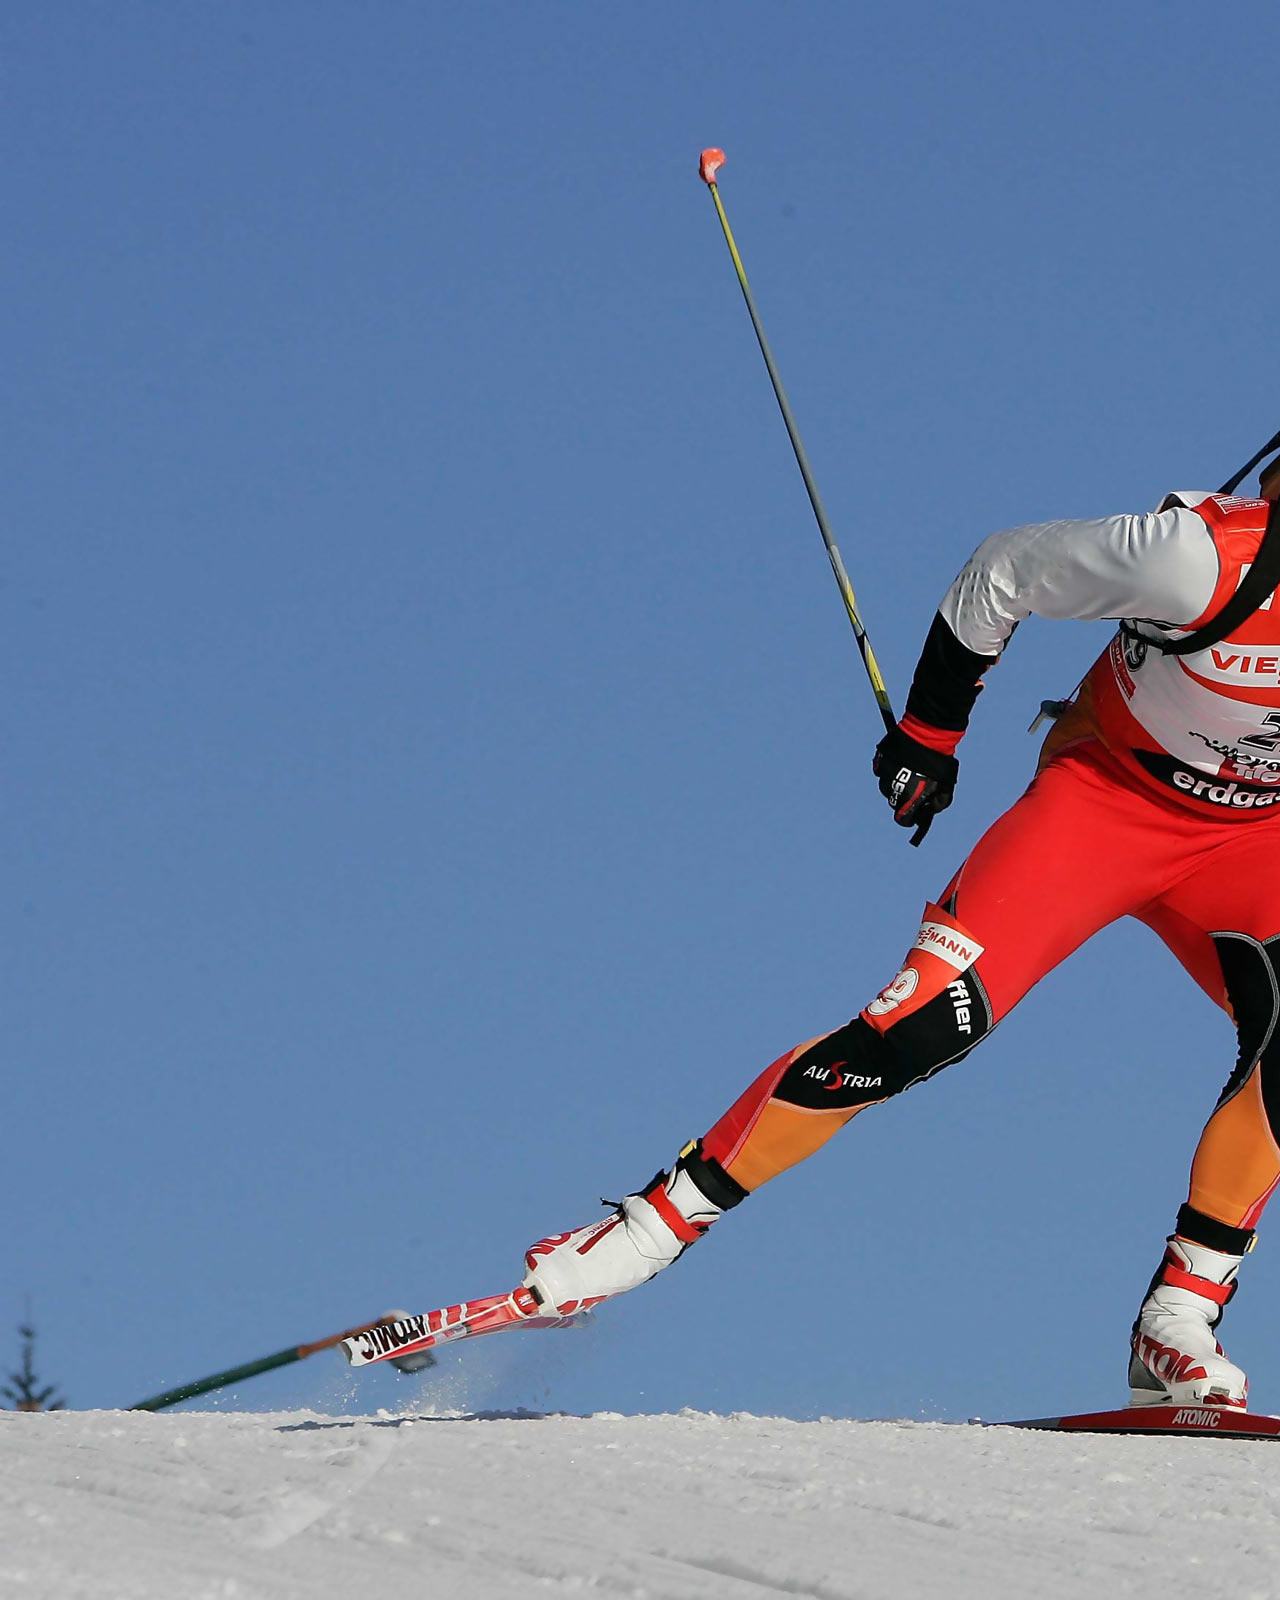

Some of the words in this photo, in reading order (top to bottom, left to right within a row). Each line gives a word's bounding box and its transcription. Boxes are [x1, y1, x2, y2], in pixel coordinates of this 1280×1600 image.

[946, 979, 972, 1035] ffler
[802, 1061, 882, 1090] AUSTRIA
[352, 1314, 427, 1360] ATOMIC
[1171, 1409, 1221, 1427] ATOMIC
